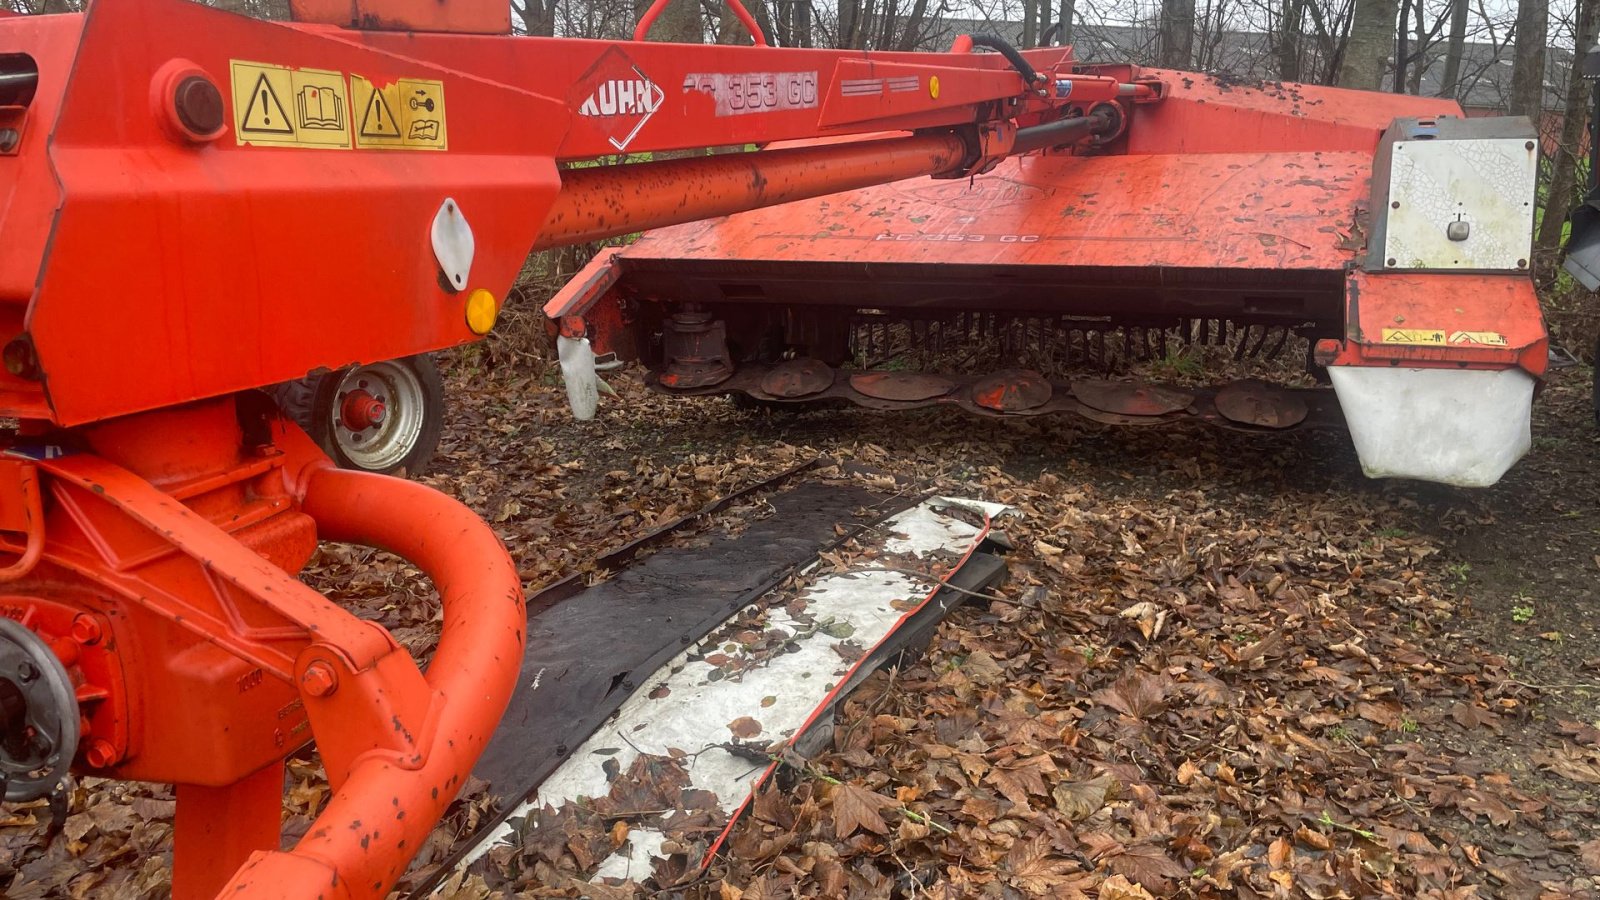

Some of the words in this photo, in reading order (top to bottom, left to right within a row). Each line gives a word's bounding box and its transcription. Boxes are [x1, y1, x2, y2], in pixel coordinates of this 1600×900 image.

[580, 80, 652, 116] KUHN
[728, 76, 778, 110] 353
[787, 74, 816, 105] GC
[999, 234, 1040, 243] GC
